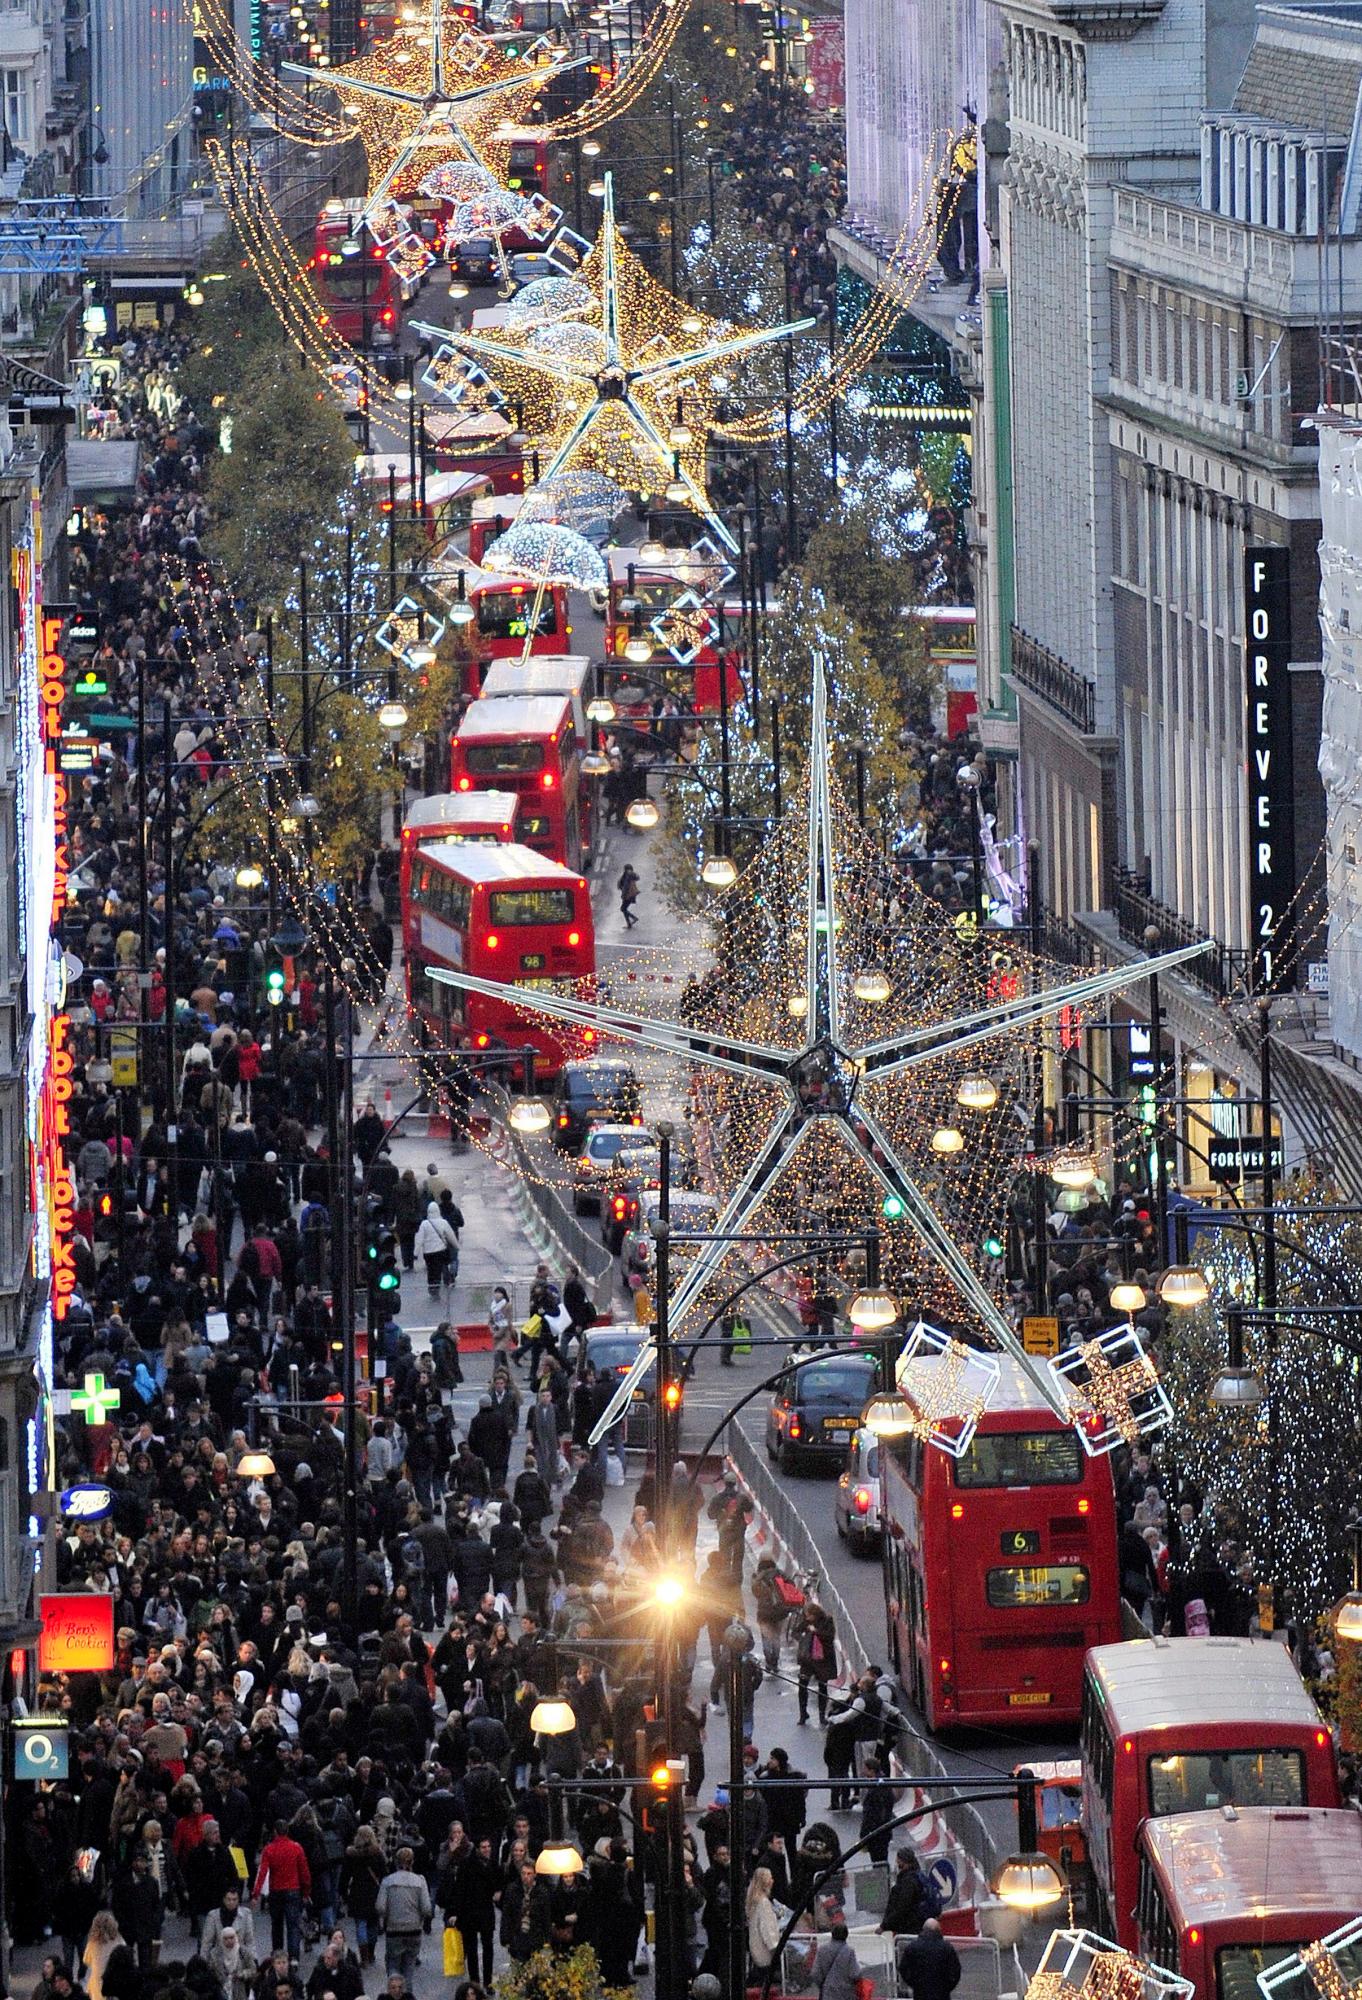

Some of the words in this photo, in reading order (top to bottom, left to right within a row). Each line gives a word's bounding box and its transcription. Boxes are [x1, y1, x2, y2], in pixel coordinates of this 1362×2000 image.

[69, 626, 97, 637] didas
[1252, 561, 1272, 874] FOREVER
[1260, 904, 1274, 982] 21
[524, 956, 540, 968] 98
[1270, 1150, 1283, 1167] 21
[1013, 1532, 1026, 1549] 6
[64, 1622, 97, 1635] Ben's
[66, 1635, 108, 1650] Cookies
